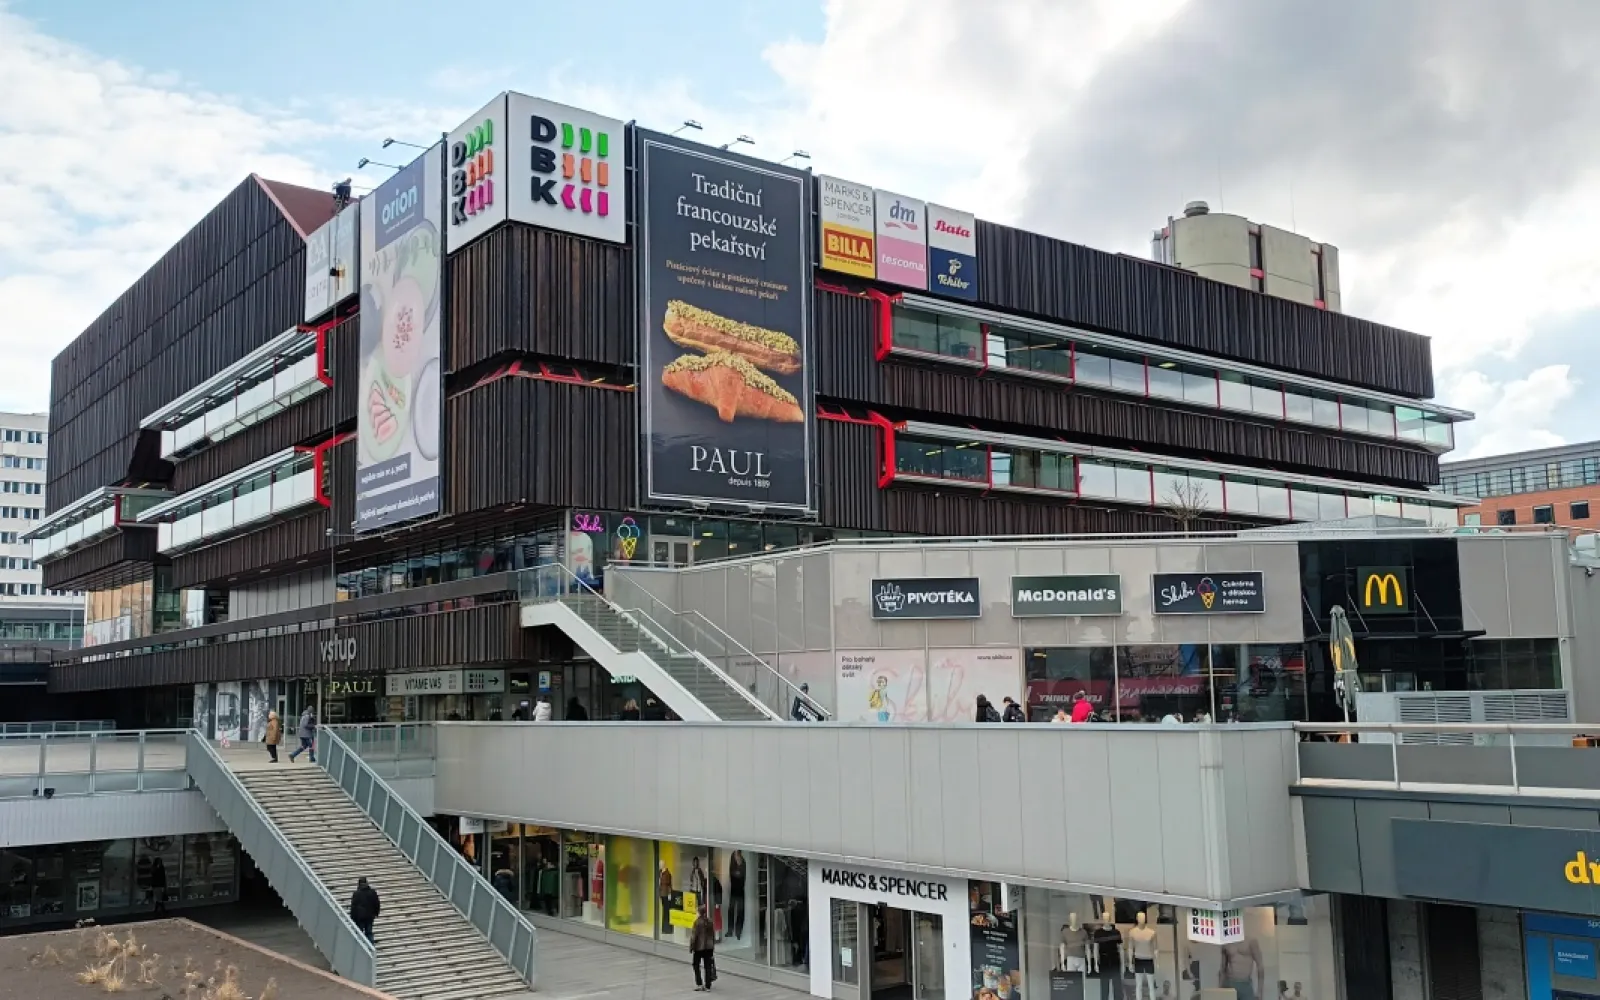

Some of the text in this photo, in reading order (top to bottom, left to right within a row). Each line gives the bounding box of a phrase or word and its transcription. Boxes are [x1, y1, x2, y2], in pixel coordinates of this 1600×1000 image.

[691, 172, 762, 207] Tradiční
[825, 181, 870, 201] MARKS &
[382, 185, 418, 225] orion
[677, 195, 777, 236] francouzské
[823, 196, 872, 217] SPENCER
[890, 200, 915, 223] dm
[690, 229, 766, 260] pekařství
[827, 233, 870, 259] BILLA
[937, 273, 970, 289] Tchibo
[690, 445, 772, 477] PAUL
[907, 589, 974, 604] PIVOTÉKA
[1018, 588, 1116, 602] McDonald's
[1161, 581, 1196, 606] Skibi
[320, 634, 357, 668] vstup
[331, 681, 377, 693] PAUL
[822, 867, 948, 901] MARKS & SPENCER
